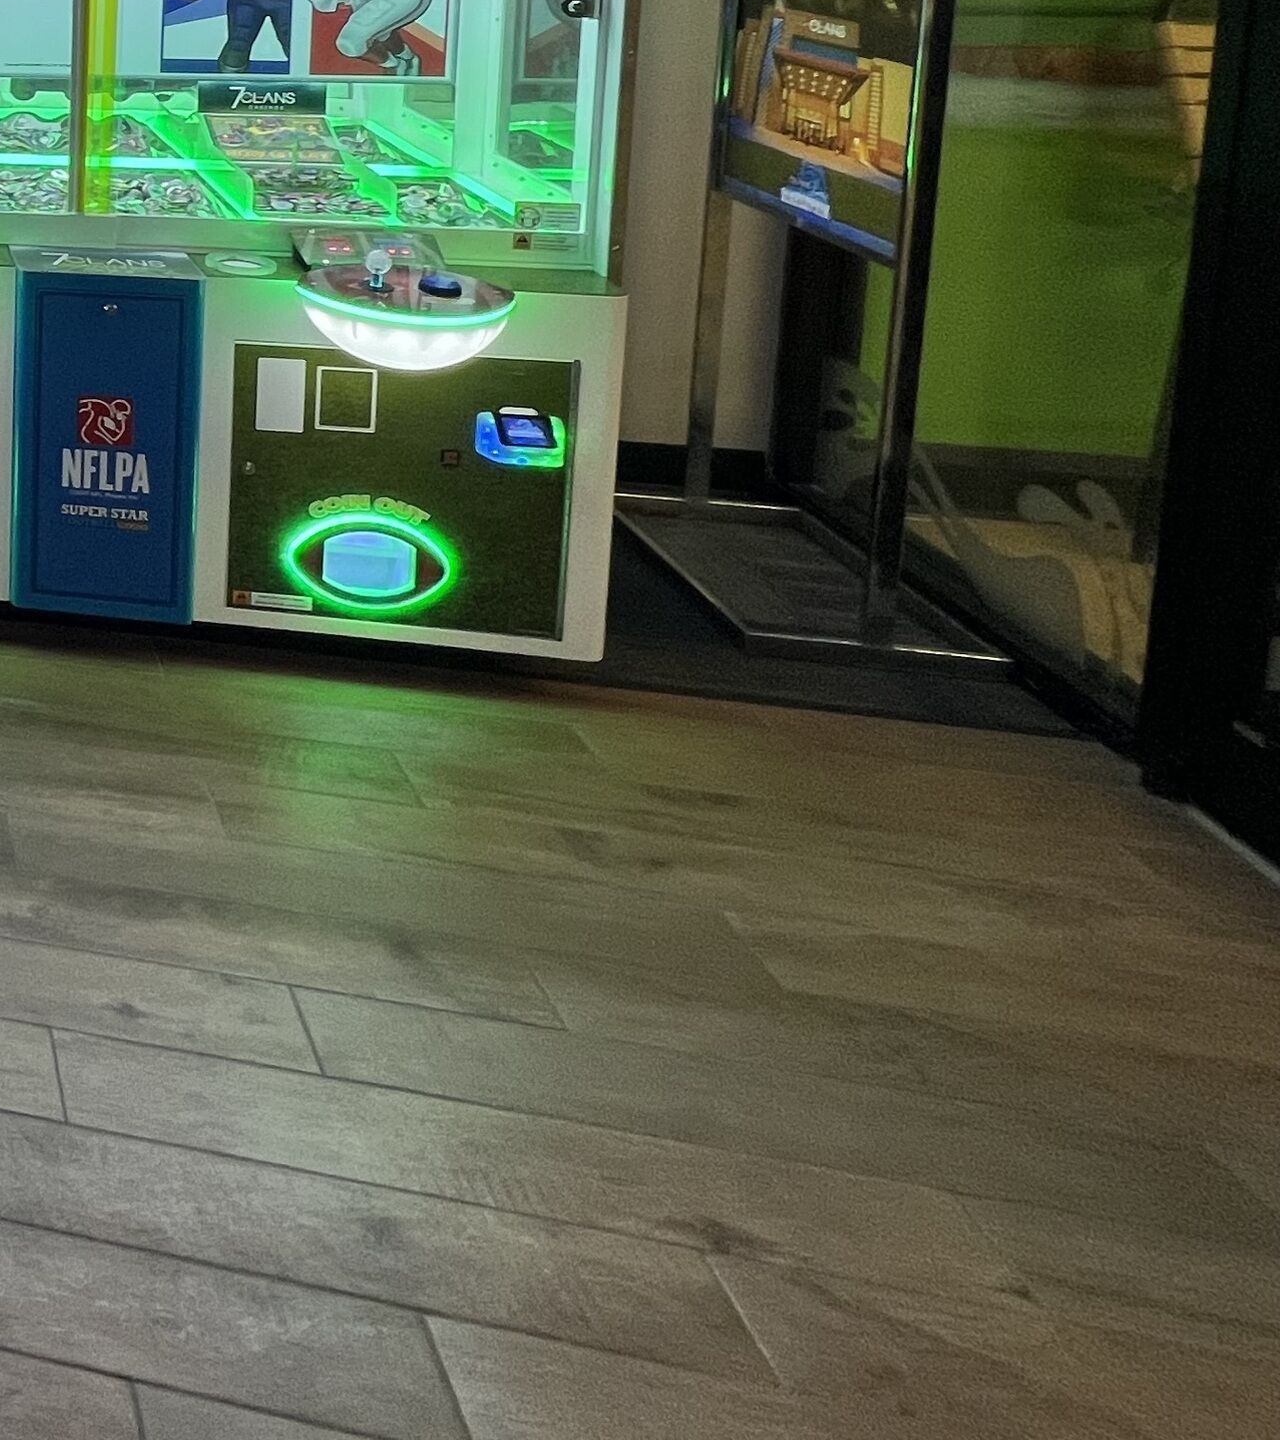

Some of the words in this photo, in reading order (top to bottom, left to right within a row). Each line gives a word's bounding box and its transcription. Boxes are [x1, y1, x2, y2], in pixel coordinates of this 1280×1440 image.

[61, 448, 150, 494] NFLPA
[61, 504, 108, 518] SUPER
[111, 508, 149, 521] STAR
[308, 494, 371, 519] COIN
[373, 496, 432, 525] OUT
